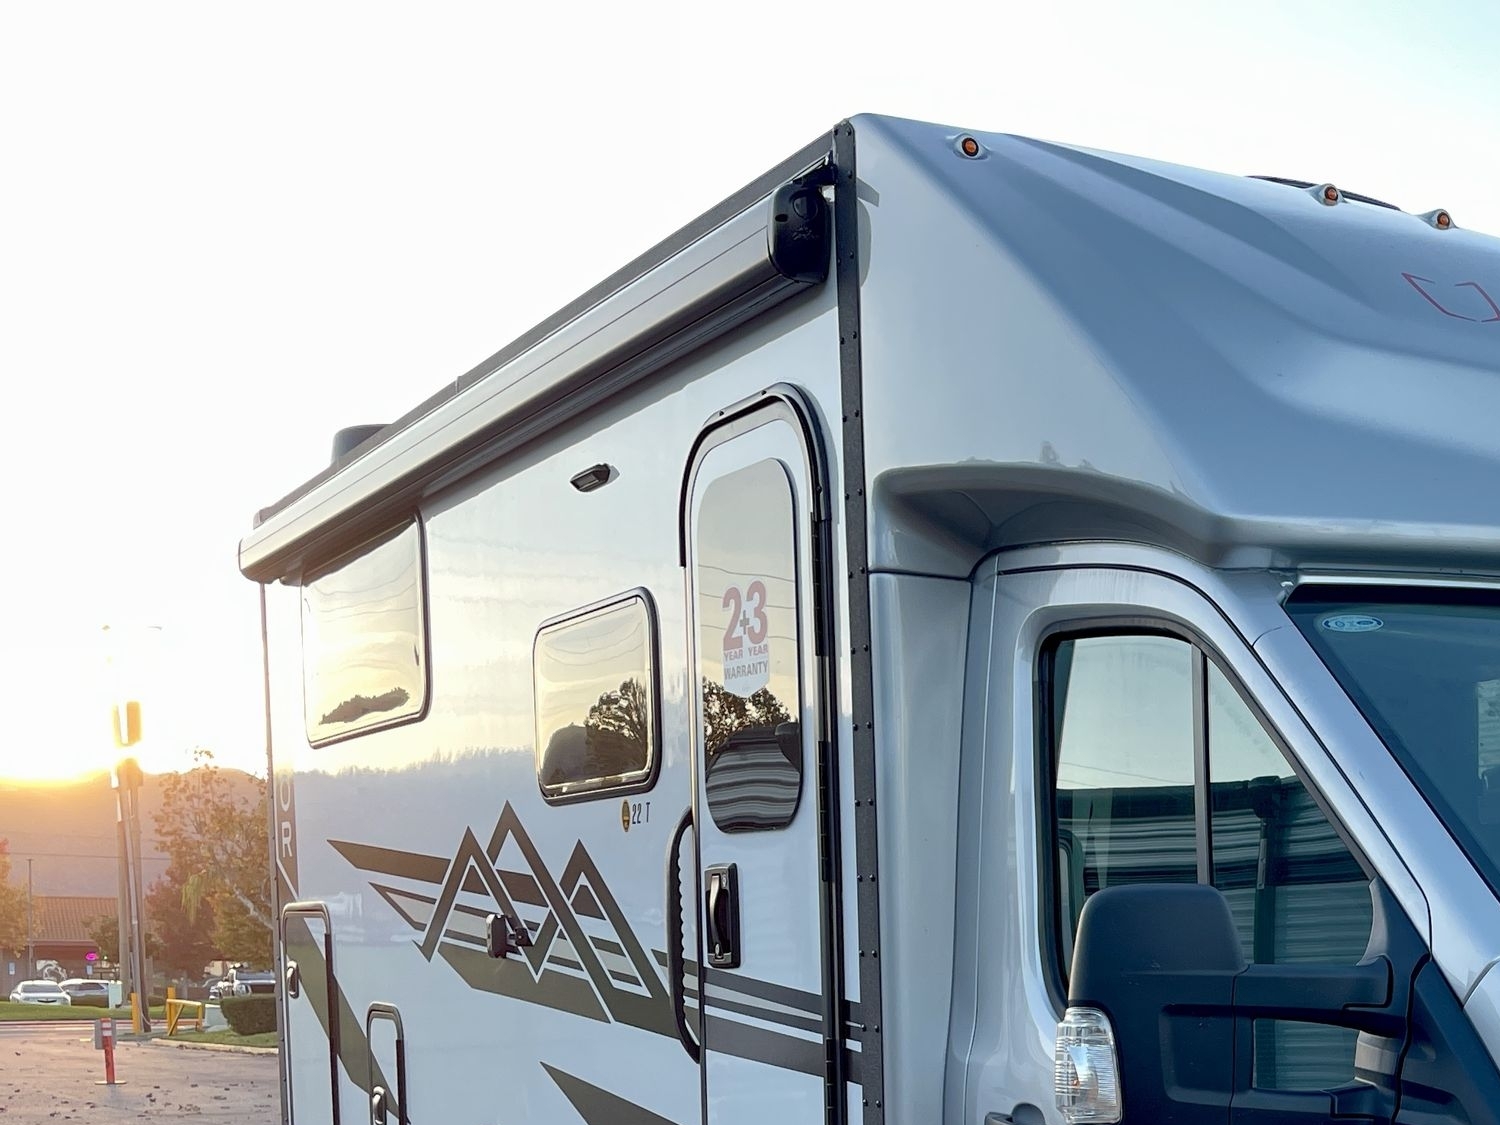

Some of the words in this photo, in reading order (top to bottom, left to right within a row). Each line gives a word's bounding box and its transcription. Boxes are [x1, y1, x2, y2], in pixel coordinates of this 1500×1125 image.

[723, 649, 743, 661] YEAR
[748, 644, 768, 656] YEAR
[724, 660, 768, 680] WARRANTY
[632, 803, 642, 824] 22
